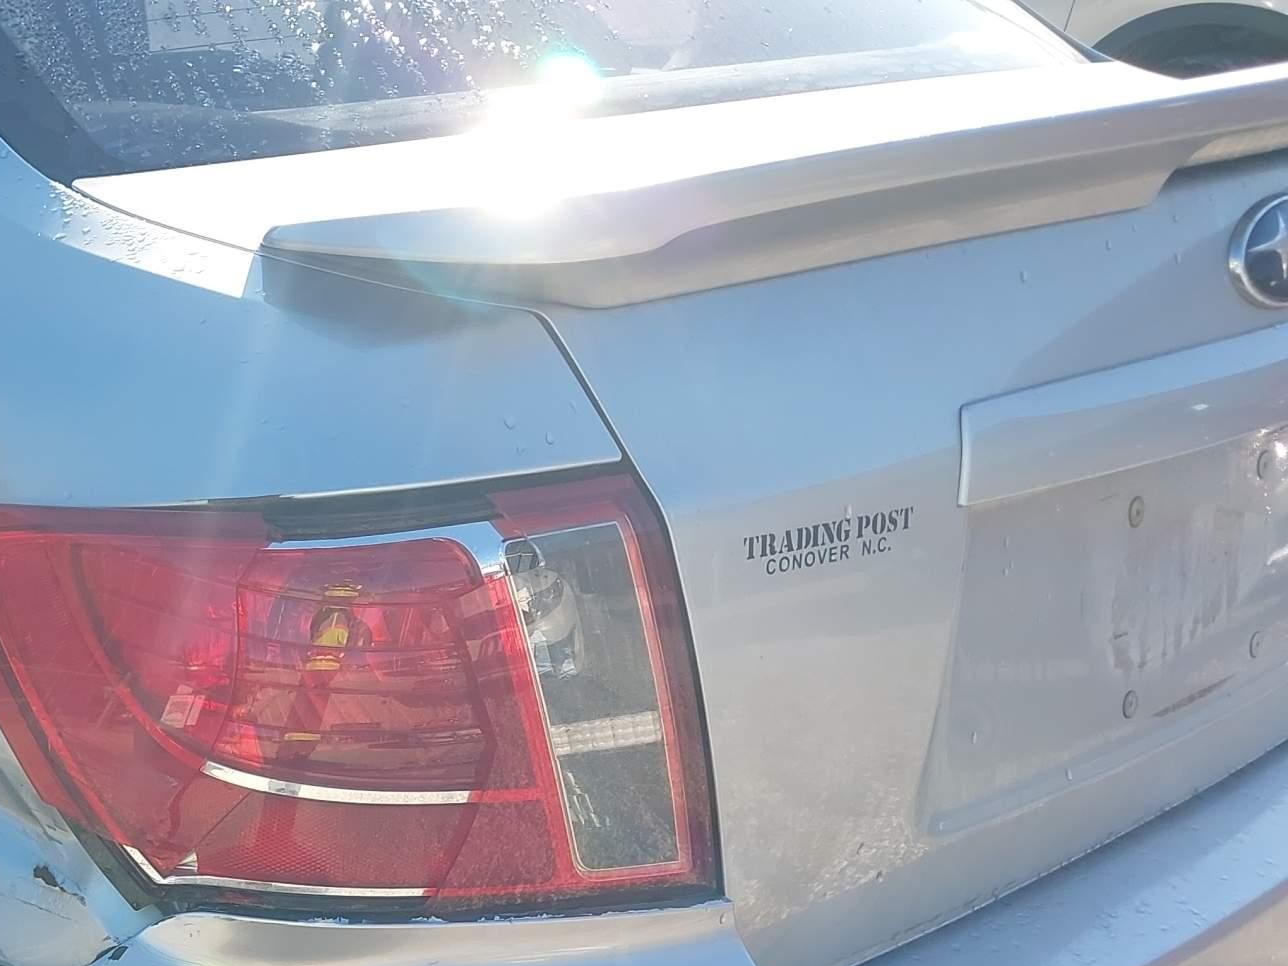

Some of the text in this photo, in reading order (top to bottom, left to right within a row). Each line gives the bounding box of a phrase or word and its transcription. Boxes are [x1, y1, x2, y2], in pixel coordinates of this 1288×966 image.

[743, 506, 914, 560] TRADING POST
[766, 537, 892, 575] CONOVER N.C.
